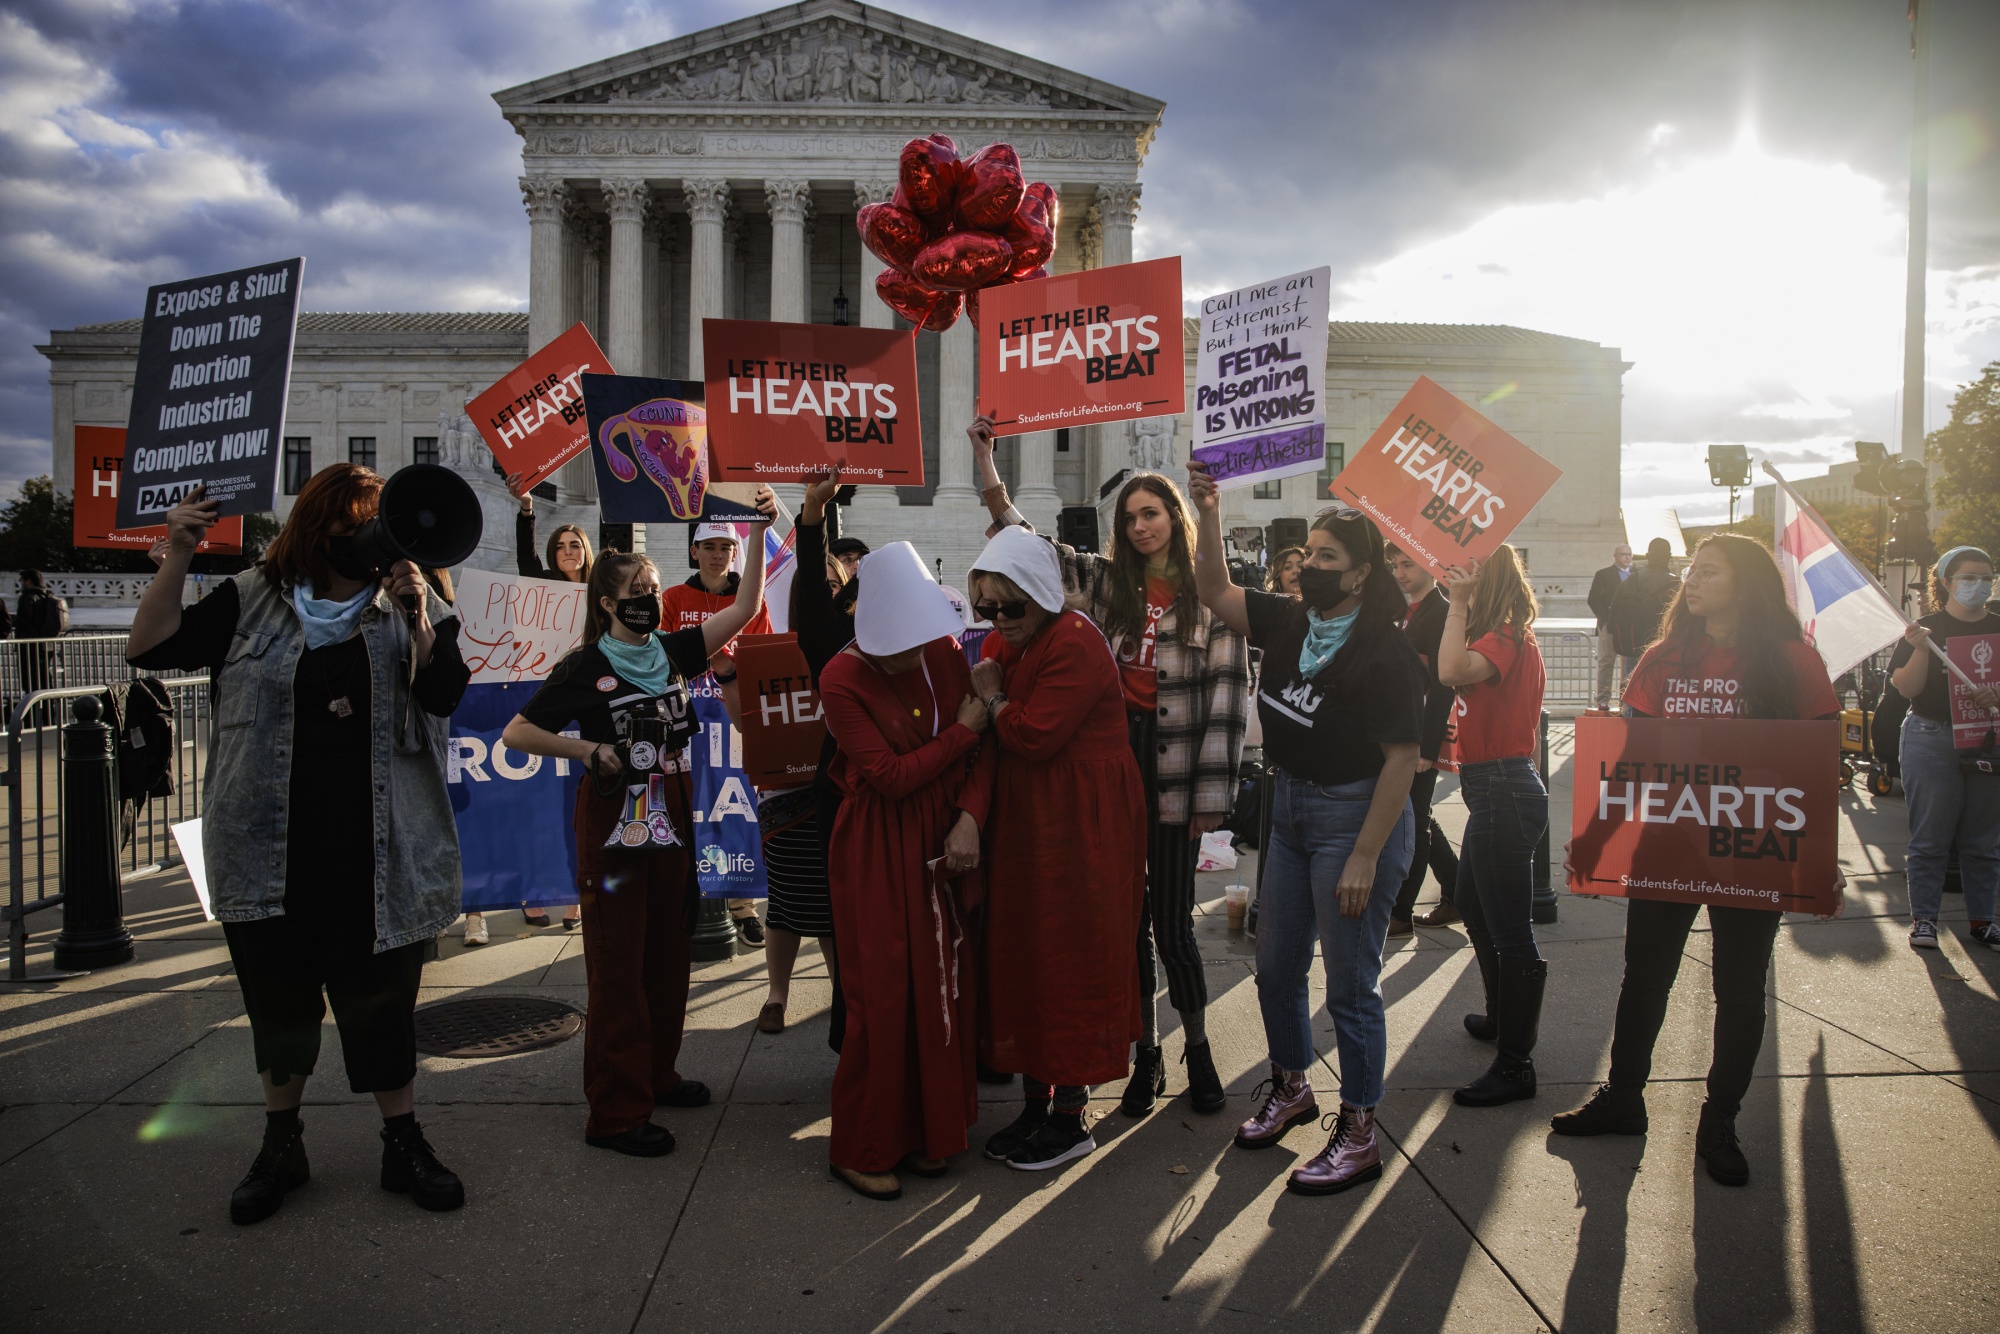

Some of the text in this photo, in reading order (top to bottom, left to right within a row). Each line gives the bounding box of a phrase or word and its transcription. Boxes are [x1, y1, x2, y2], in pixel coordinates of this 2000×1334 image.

[716, 138, 774, 152] EQUAL
[780, 138, 843, 152] JUSTICE
[155, 268, 288, 318] Expose & Shut
[1205, 275, 1313, 314] Call me an
[1000, 305, 1110, 339] LET THEIR
[1212, 295, 1308, 332] Extremist
[170, 314, 261, 352] Down The
[1000, 315, 1160, 372] HEARTS
[1206, 316, 1311, 353] But I think
[169, 354, 251, 390] Abortion
[728, 359, 847, 382] LET THEIR
[1086, 348, 1160, 384] BEAT
[1219, 337, 1302, 378] FETAL
[490, 373, 560, 429] LET THEIR
[729, 377, 897, 419] HEARTS
[1197, 365, 1315, 411] Poisoning
[159, 391, 252, 431] Industrial
[560, 396, 586, 425] BE
[639, 406, 700, 424] COUNTER
[1018, 401, 1142, 425] StudentsforLifeAction.org
[1206, 394, 1315, 433] IS WRONG
[825, 416, 898, 444] BEAT
[1252, 425, 1319, 471] Atheist
[1402, 413, 1485, 479] LET THEIR
[93, 456, 124, 471] LET
[133, 428, 269, 474] Complex NOW!
[205, 482, 256, 496] ANTI-ABORTION
[206, 475, 251, 487] PROGRESSIVE
[1381, 426, 1505, 529] HEARTS
[1358, 495, 1438, 567] StudentsforLifeAction.org
[1420, 494, 1485, 548] BEAT
[485, 582, 586, 634] PROTECT
[680, 611, 699, 622] THE
[465, 626, 555, 682] Life
[758, 677, 792, 695] LET
[1667, 678, 1699, 694] THE
[1962, 709, 1985, 720] FOR
[1600, 761, 1742, 786] LET THEIR
[1599, 780, 1806, 831] HEARTS
[1709, 825, 1806, 862] BEAT
[727, 875, 754, 883] History
[1620, 875, 1779, 903] StudentsforLifeAction.org
